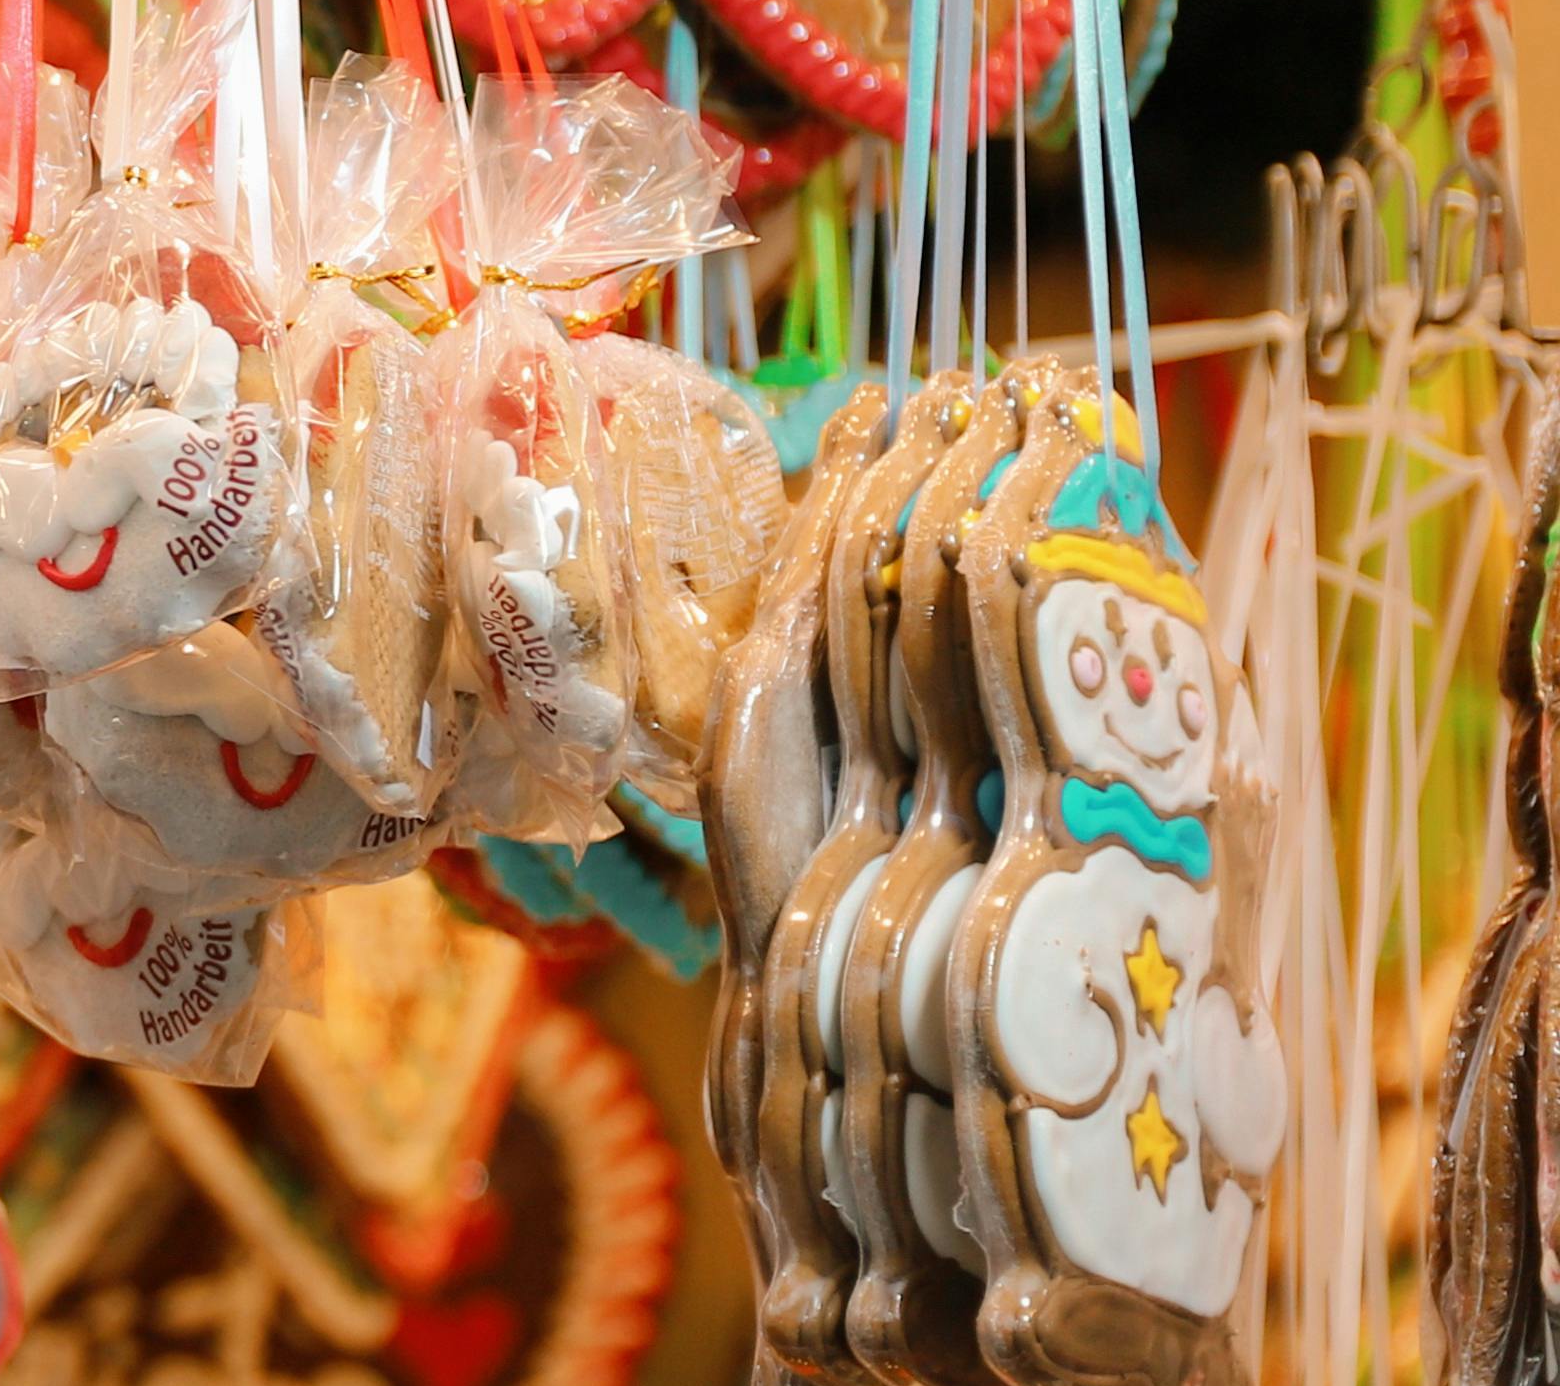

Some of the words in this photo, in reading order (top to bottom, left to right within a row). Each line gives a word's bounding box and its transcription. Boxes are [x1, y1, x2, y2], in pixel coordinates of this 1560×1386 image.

[158, 433, 220, 518] 100%
[166, 410, 259, 577] Handarbeit
[480, 612, 523, 681] 100%
[138, 924, 194, 1000] 100%
[138, 918, 233, 1045] Handarbeit
